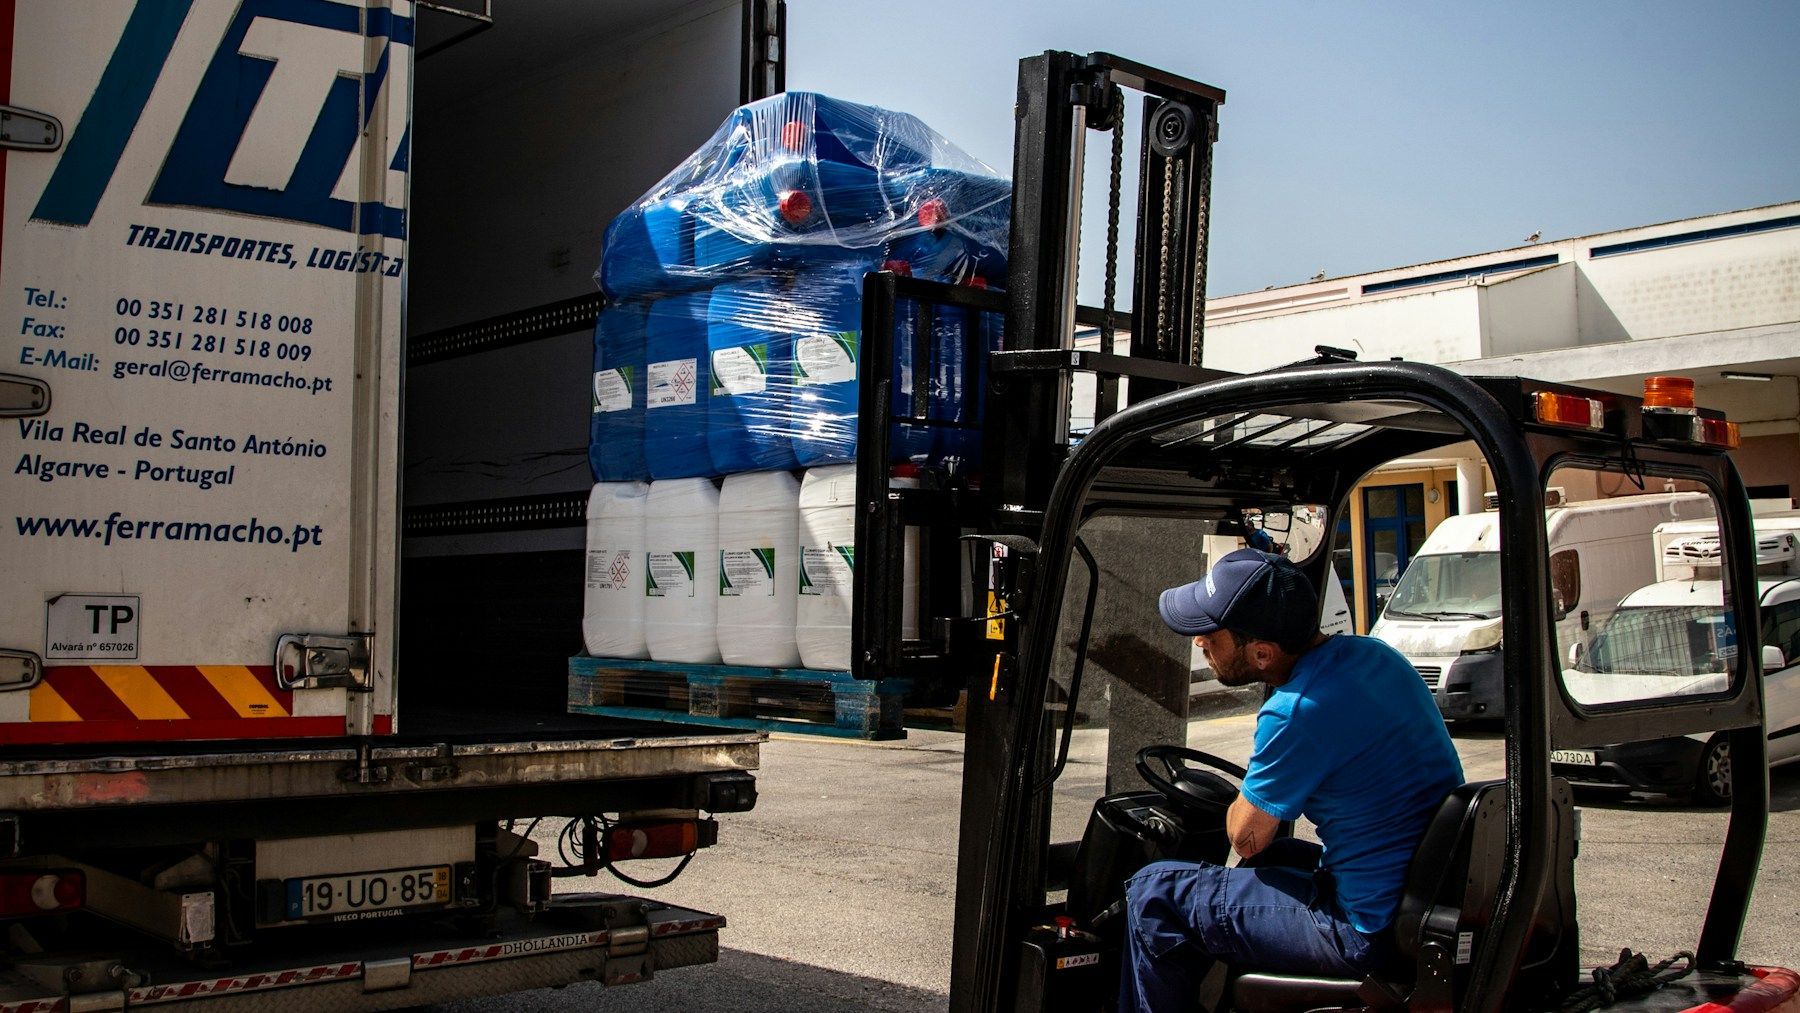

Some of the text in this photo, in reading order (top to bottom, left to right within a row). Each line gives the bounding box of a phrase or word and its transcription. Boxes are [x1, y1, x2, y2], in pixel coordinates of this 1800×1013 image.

[126, 223, 298, 270] TRANSPORTES,
[25, 287, 313, 335] Tel.: 00 351 281 518 008
[21, 317, 312, 362] Fax: 00 351 281 518 009
[20, 347, 333, 395] E-Mail: geral@ferramacho.pt
[18, 418, 327, 458] Vila Real de Santo António
[15, 453, 109, 482] Algarve
[134, 460, 235, 490] Portugal
[16, 512, 324, 553] www.ferramacho.pt
[85, 604, 134, 635] TP
[1320, 619, 1347, 629] EUGEOT
[51, 641, 84, 652] Alvará
[99, 642, 134, 652] 657026
[334, 909, 404, 922] IVECO PORTUGAL
[503, 934, 588, 955] DHOLLANDIA
